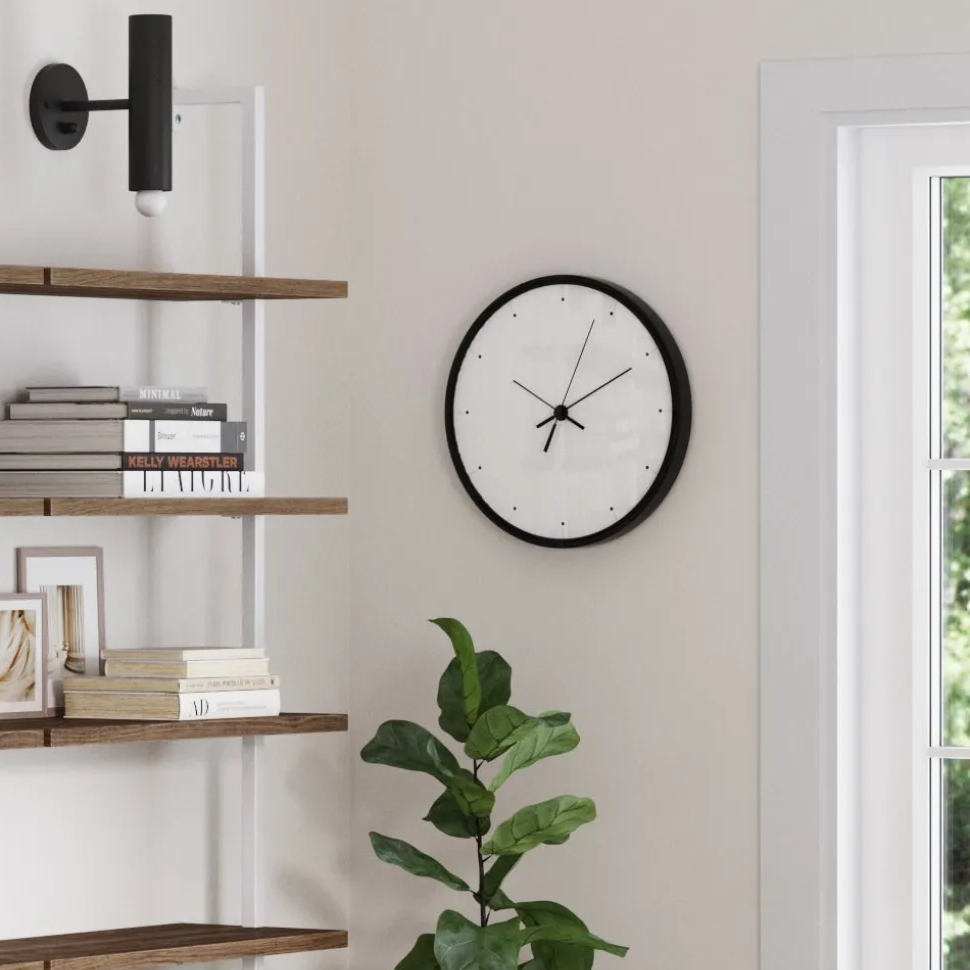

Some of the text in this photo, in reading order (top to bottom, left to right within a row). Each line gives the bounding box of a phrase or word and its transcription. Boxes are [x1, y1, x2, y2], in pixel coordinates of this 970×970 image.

[139, 389, 182, 400] MINIMAL
[191, 407, 214, 418] Nature
[128, 456, 238, 468] KELLY WEARSTLER
